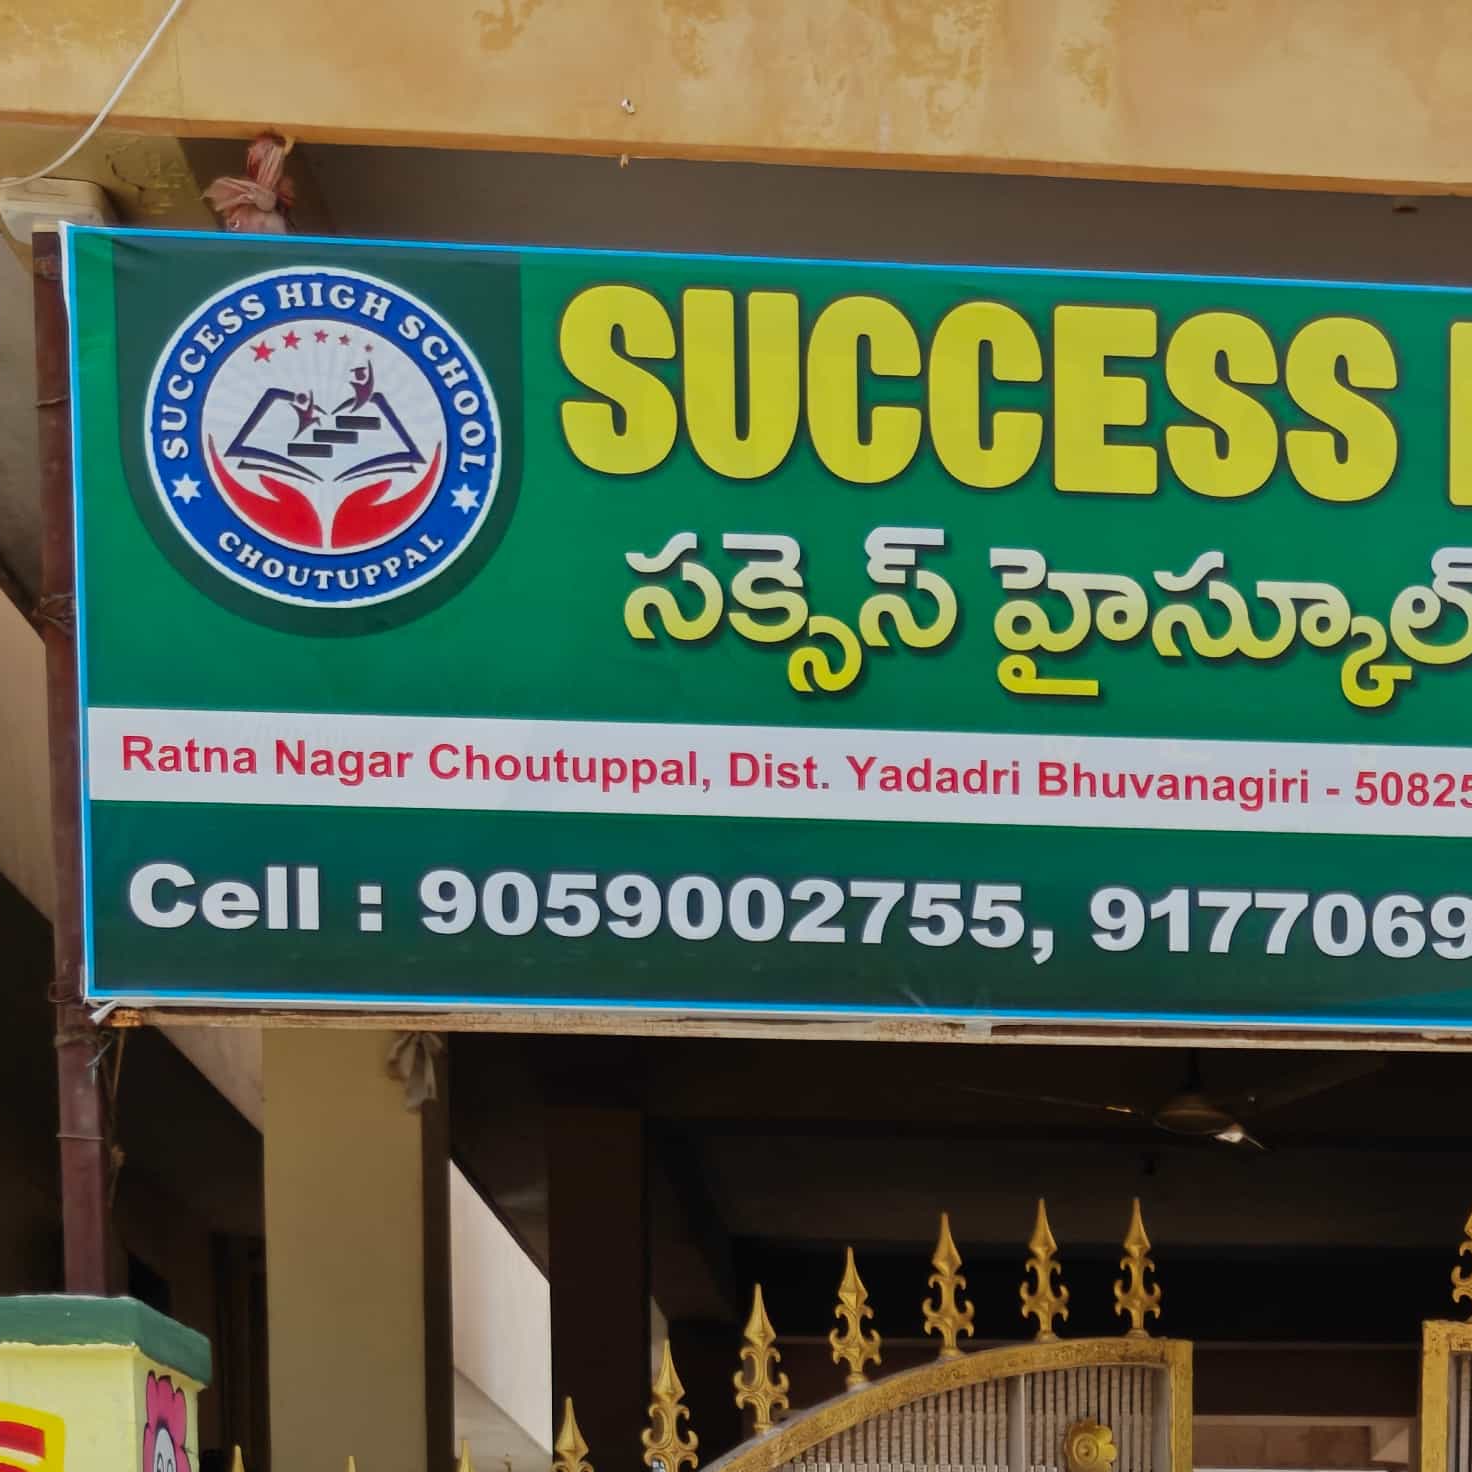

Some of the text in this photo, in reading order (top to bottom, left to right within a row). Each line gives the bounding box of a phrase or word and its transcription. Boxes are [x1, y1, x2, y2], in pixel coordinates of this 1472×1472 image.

[161, 282, 486, 474] SUCCESS HIGH SCHOOL
[558, 284, 1398, 502] SUCCESS
[218, 531, 444, 590] CHOUTUPPAL
[121, 733, 259, 777] Ratna
[273, 738, 414, 789] Nagar
[428, 741, 714, 798] Choutuppal,
[728, 750, 832, 796] Dist.
[846, 754, 1021, 799] Yadadri
[1036, 758, 1308, 812] Bhuvanagiri
[126, 862, 321, 933] Cell
[418, 867, 1054, 963] 9059002755,
